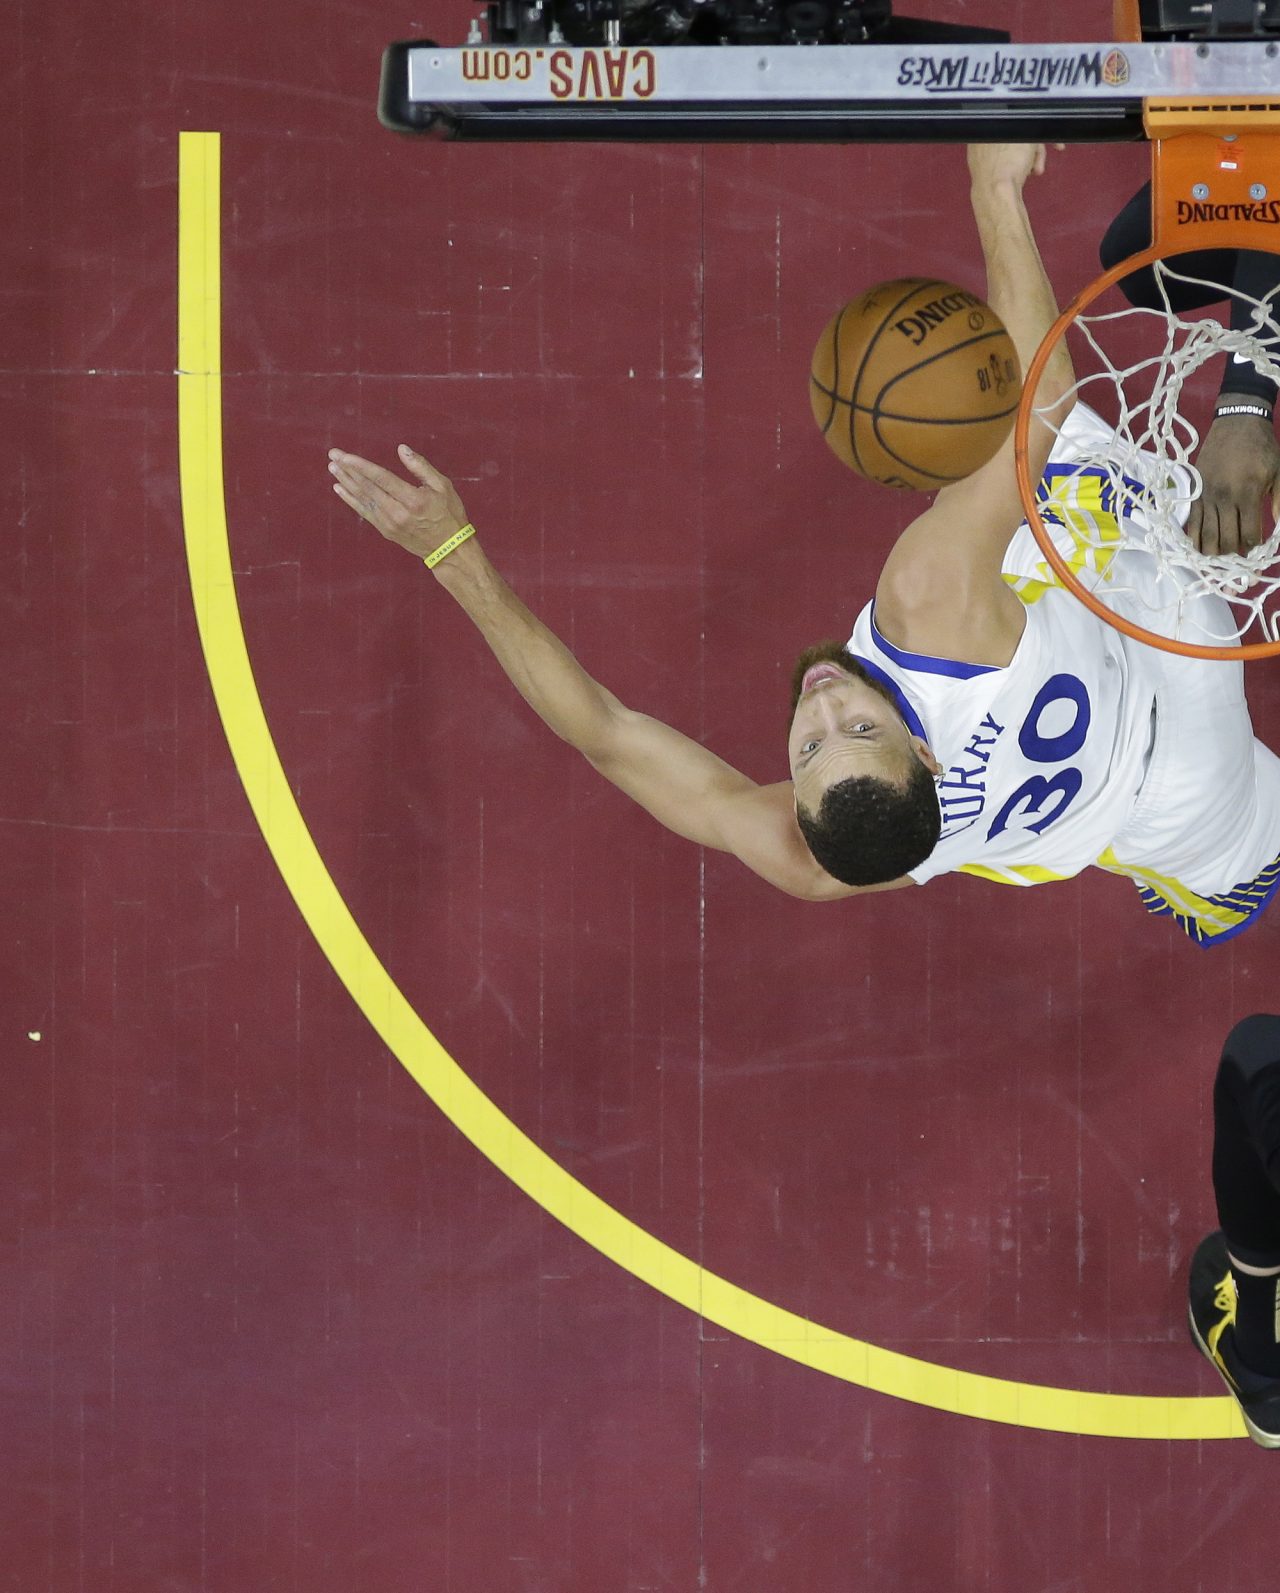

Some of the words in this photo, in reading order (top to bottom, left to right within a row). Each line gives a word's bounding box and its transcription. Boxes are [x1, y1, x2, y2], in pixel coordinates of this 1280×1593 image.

[461, 49, 657, 100] CAVS.com
[897, 56, 994, 93] TAKES
[1177, 200, 1280, 225] SPALDING
[985, 673, 1091, 844] 30
